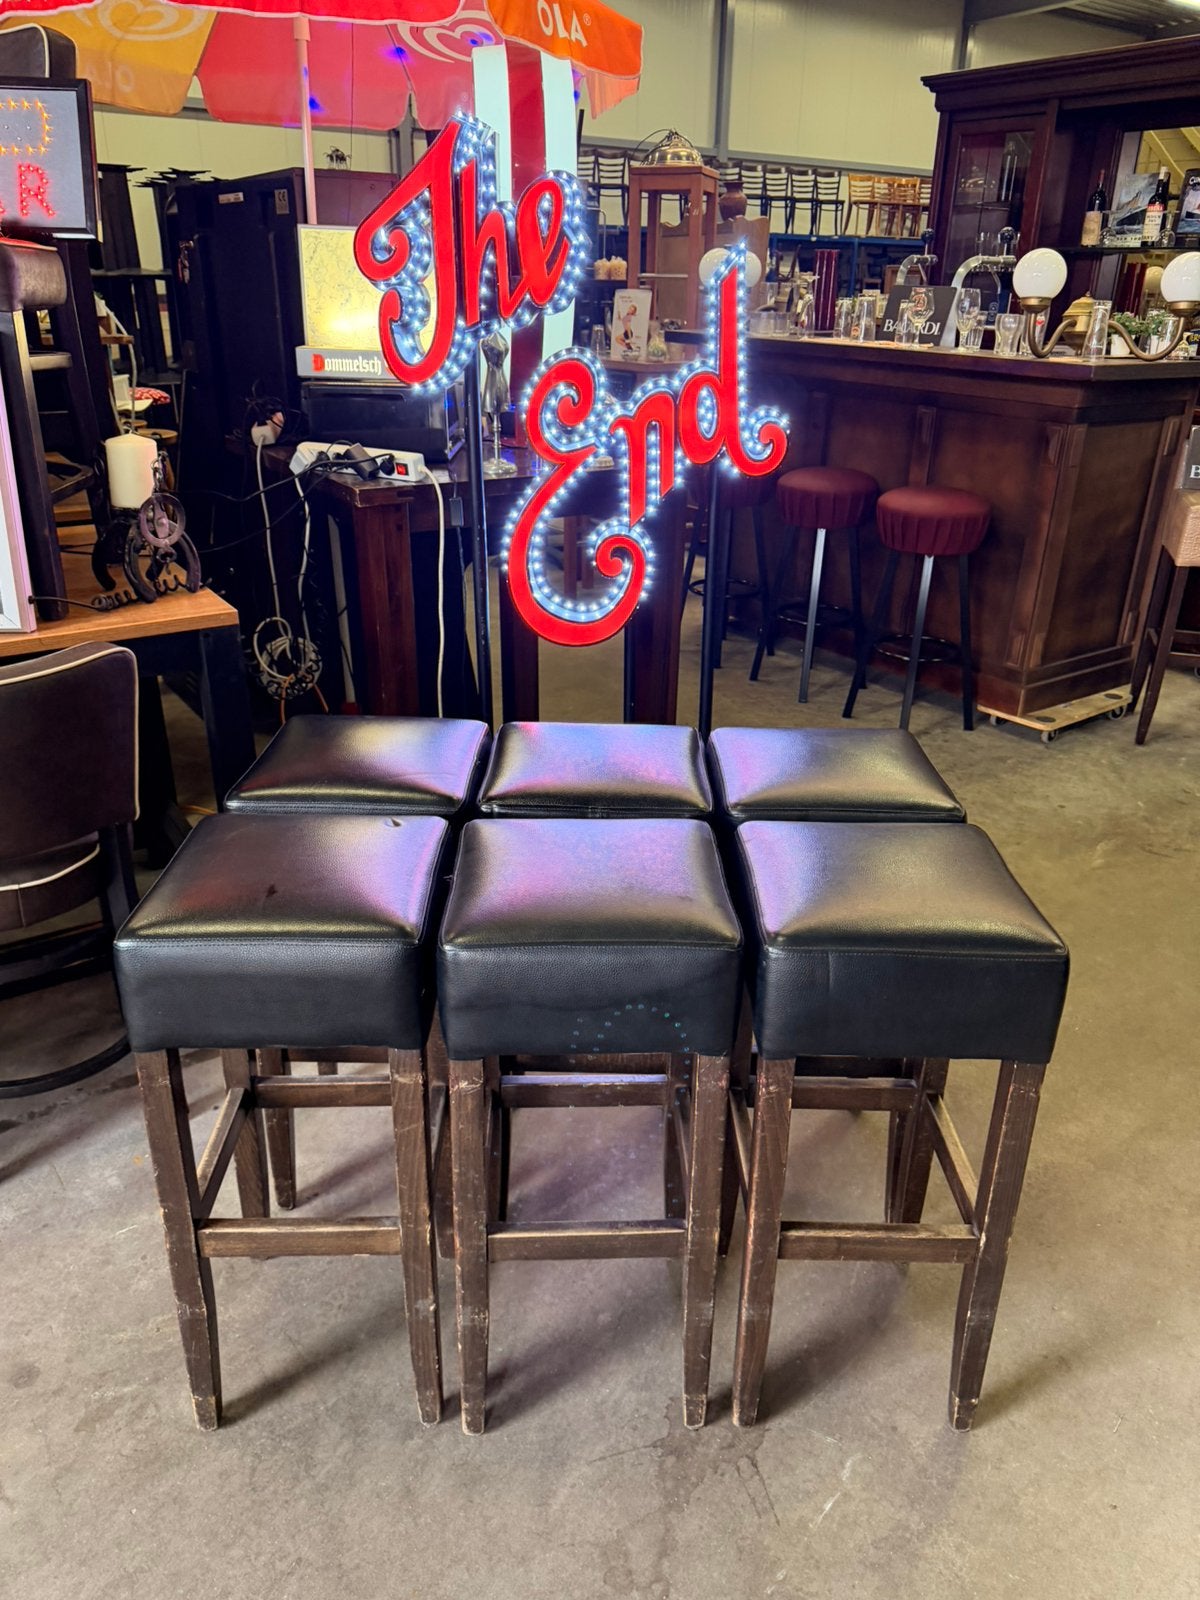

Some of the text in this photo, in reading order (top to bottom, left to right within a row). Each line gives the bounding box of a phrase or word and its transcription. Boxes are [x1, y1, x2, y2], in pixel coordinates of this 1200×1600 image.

[0, 162, 56, 218] R
[354, 118, 576, 386] The
[312, 353, 382, 376] Dommelsch
[505, 260, 788, 647] End
